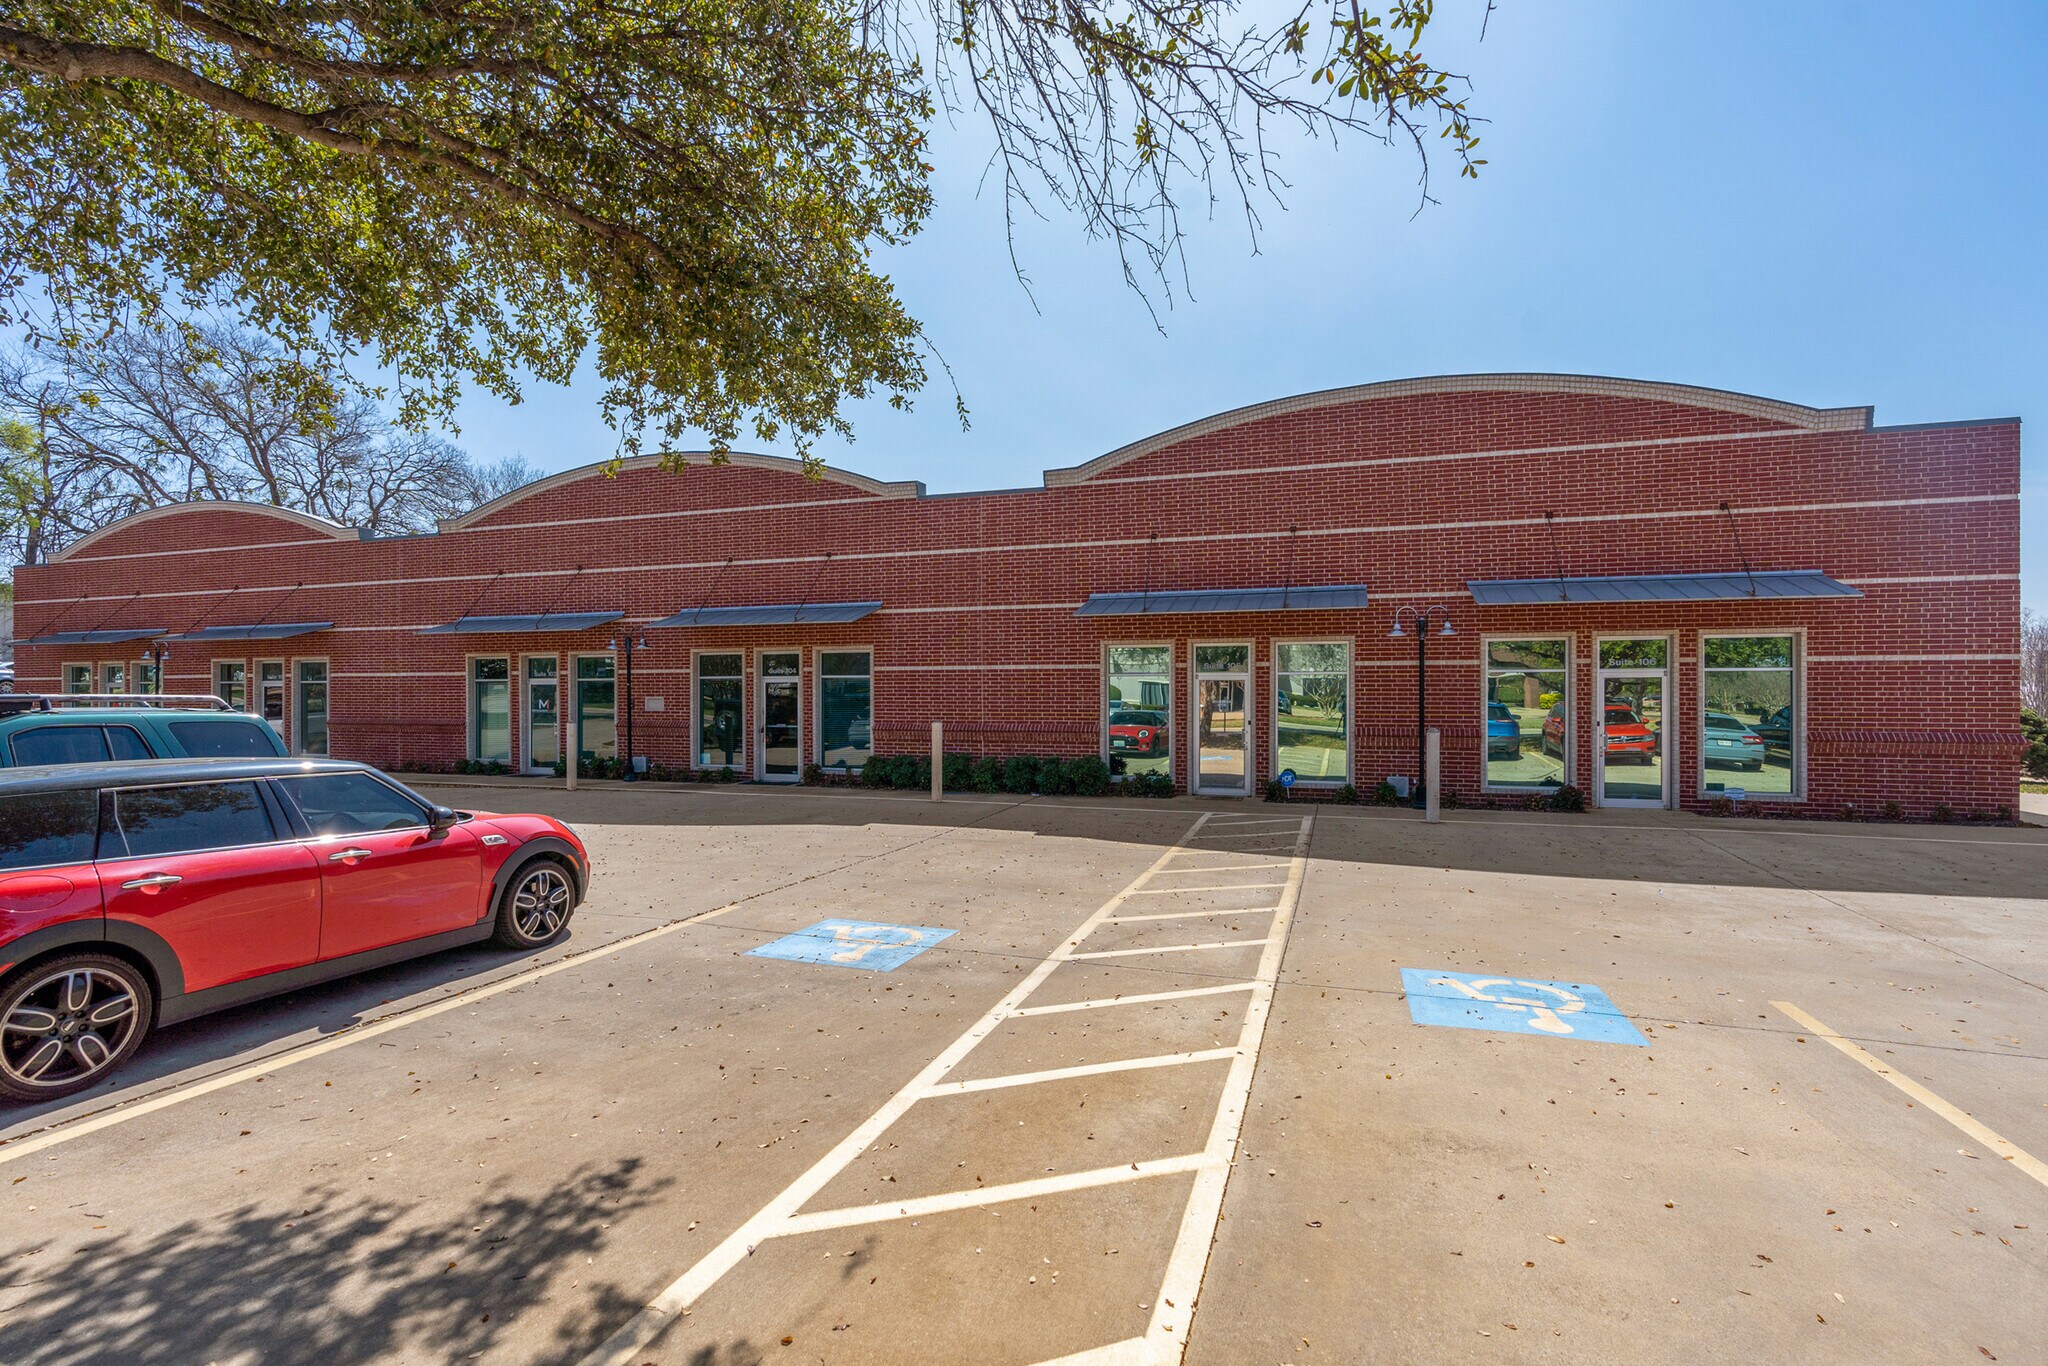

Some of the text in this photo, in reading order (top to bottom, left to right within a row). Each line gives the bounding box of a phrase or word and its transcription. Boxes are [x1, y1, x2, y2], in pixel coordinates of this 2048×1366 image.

[1203, 662, 1224, 670] Suite
[1608, 658, 1657, 666] Suite 106
